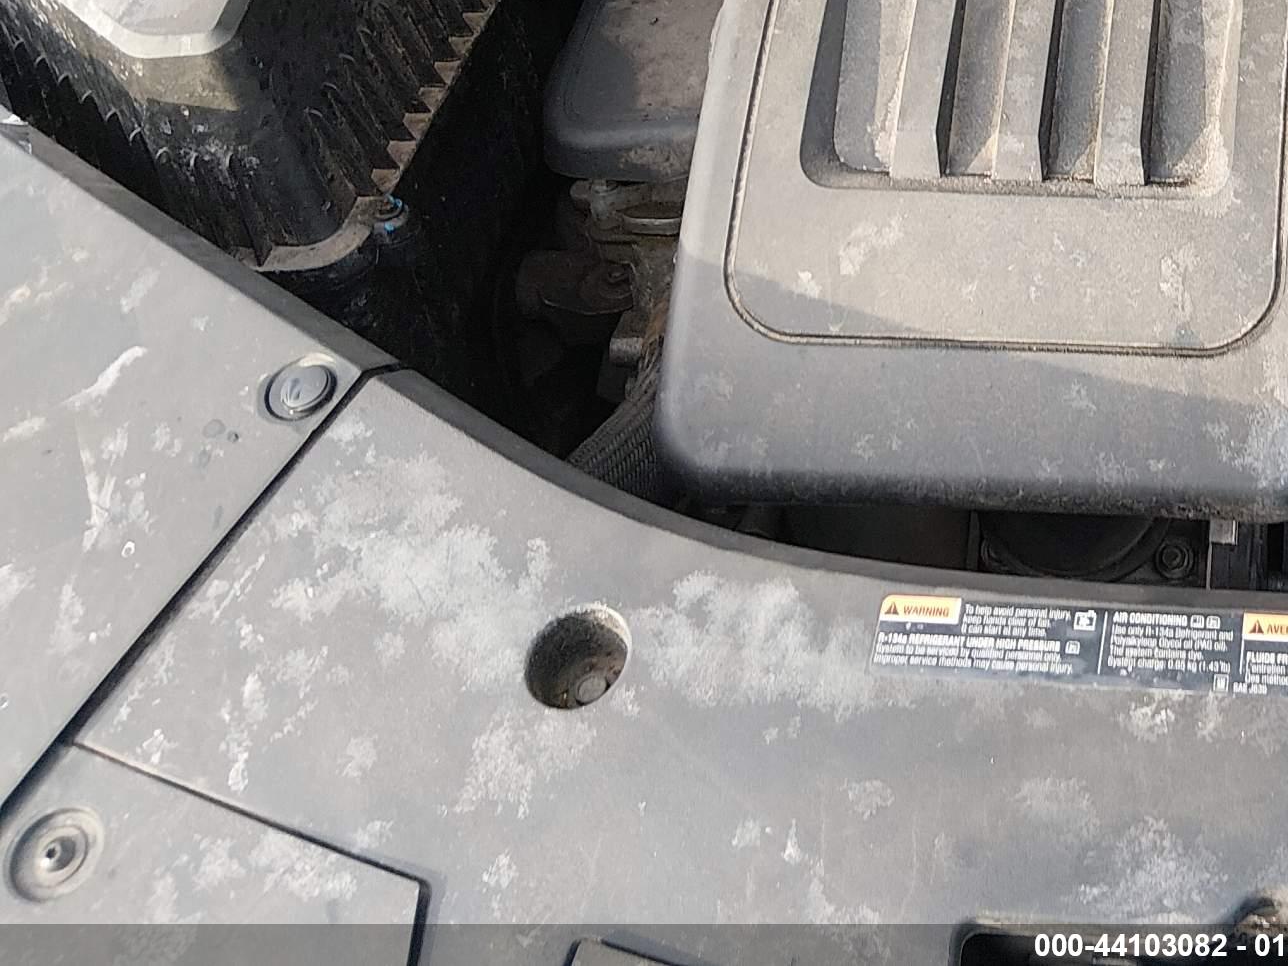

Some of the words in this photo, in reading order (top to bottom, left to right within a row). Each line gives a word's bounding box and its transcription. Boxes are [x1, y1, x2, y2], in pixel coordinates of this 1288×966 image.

[904, 605, 950, 617] WARNING
[966, 604, 974, 614] To
[976, 605, 992, 615] help
[993, 606, 1014, 615] avoid
[1113, 612, 1128, 623] AIR
[1129, 613, 1187, 626] CONDITIONING
[966, 637, 995, 648] UNDER
[996, 639, 1016, 650] HIGH
